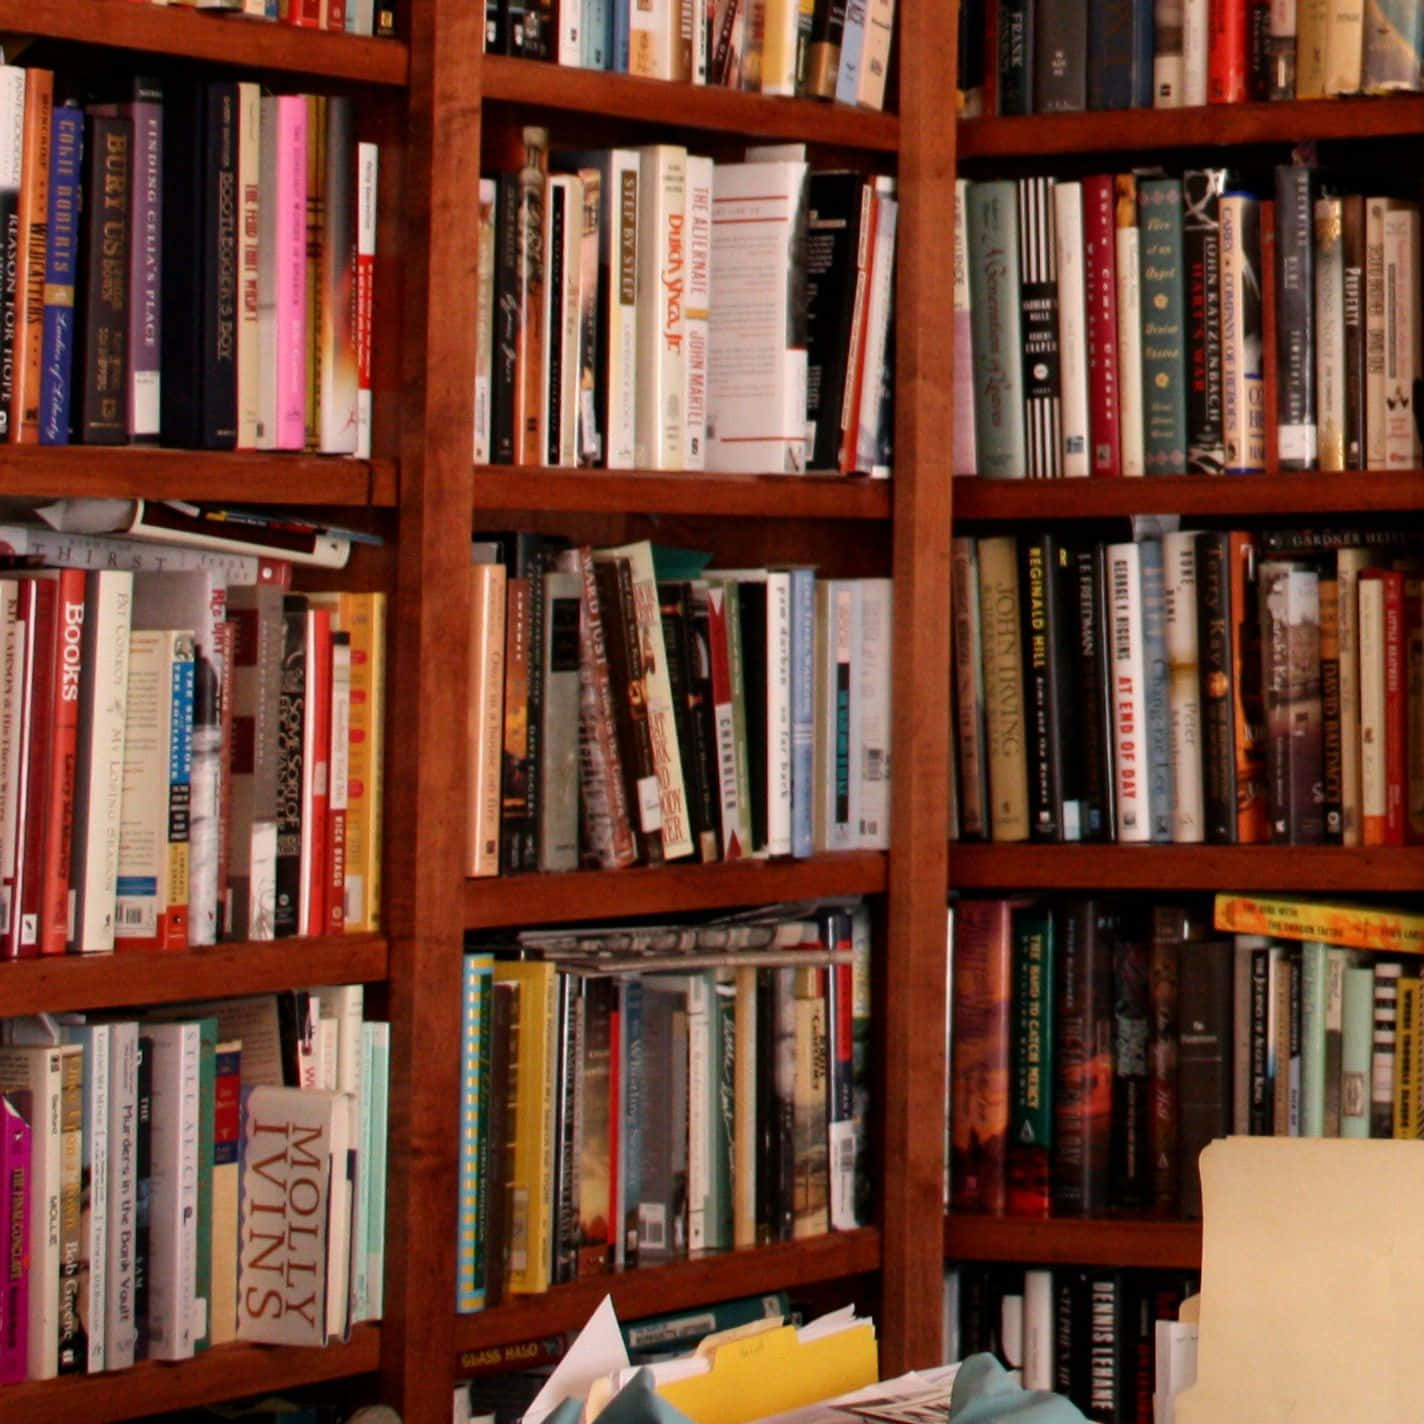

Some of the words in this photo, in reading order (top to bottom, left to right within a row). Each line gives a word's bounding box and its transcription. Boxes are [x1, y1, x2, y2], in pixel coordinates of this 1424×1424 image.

[146, 119, 160, 202] FINDING
[622, 177, 635, 224] STEP
[622, 231, 634, 250] BY
[620, 256, 634, 295] STEP
[143, 286, 157, 347] PLACE
[1029, 548, 1042, 629] REGINALD
[1033, 635, 1046, 668] HILL
[1119, 677, 1133, 696] AT
[1119, 702, 1134, 732] END
[1120, 740, 1136, 760] OF
[1120, 766, 1137, 799] DAY
[246, 1120, 289, 1320] IVINS
[286, 1124, 322, 1327] MOLLY
[1092, 1283, 1113, 1343] DENNIS
[1093, 1349, 1114, 1410] LEHANE
